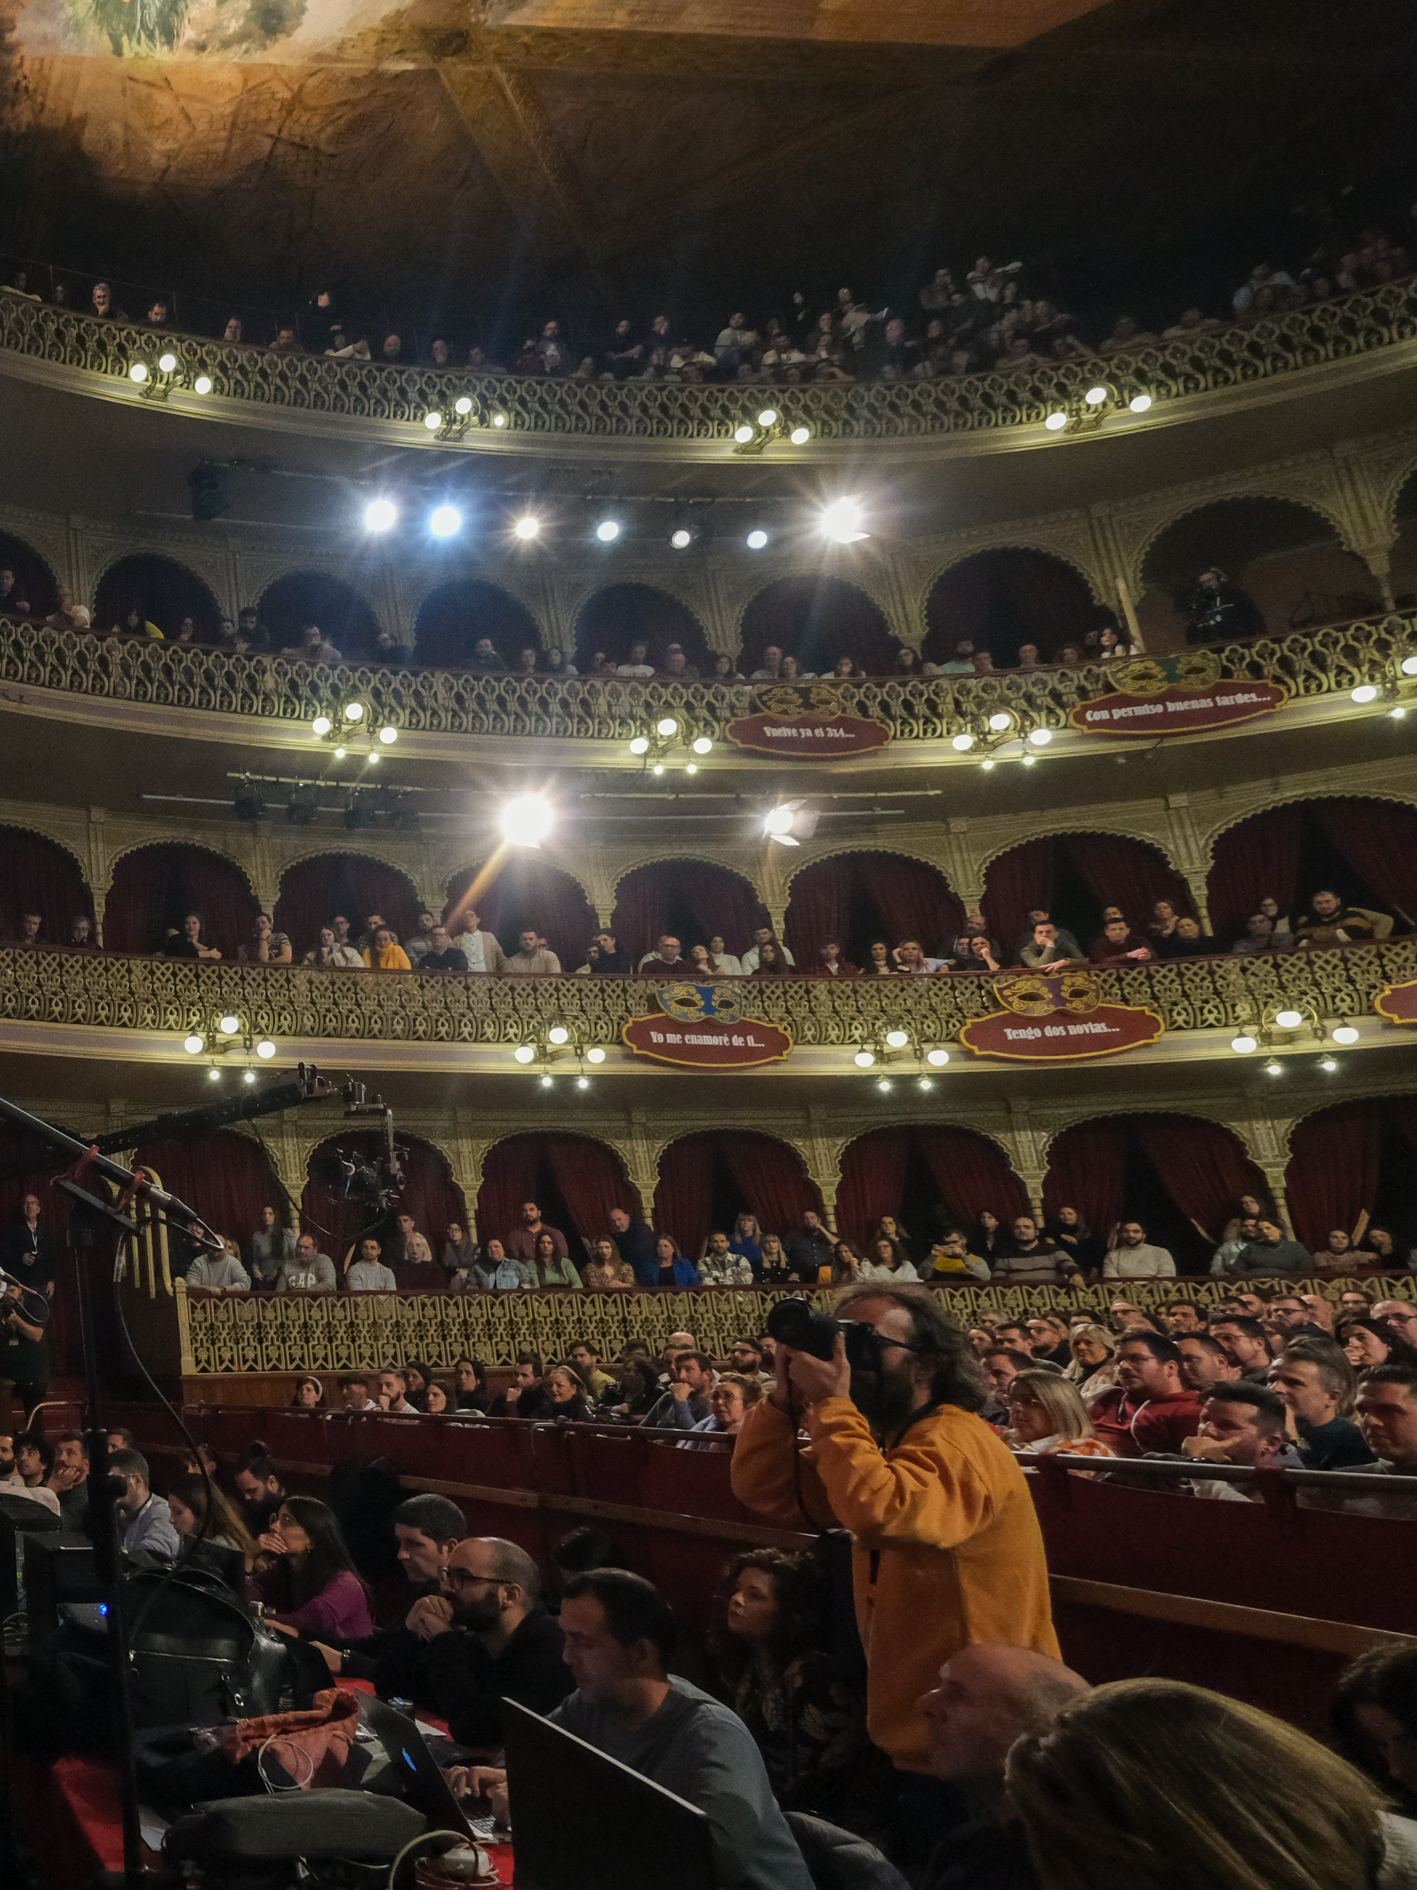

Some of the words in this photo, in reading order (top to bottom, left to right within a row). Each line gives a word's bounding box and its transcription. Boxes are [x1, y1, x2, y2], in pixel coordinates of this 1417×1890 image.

[1085, 708, 1110, 722] Con
[1112, 702, 1164, 721] permiso
[1165, 698, 1214, 713] buenas
[1215, 692, 1272, 707] tardes...
[763, 726, 799, 738] Vuelve
[799, 727, 813, 739] ya
[814, 727, 825, 738] el
[825, 727, 855, 738] 3x4...
[649, 1030, 665, 1044] Yo
[665, 1032, 683, 1044] me
[684, 1033, 731, 1047] enamoré
[732, 1034, 746, 1047] de
[1004, 1026, 1042, 1041] Tengo
[1043, 1024, 1066, 1038] dos
[1067, 1021, 1121, 1036] novias...
